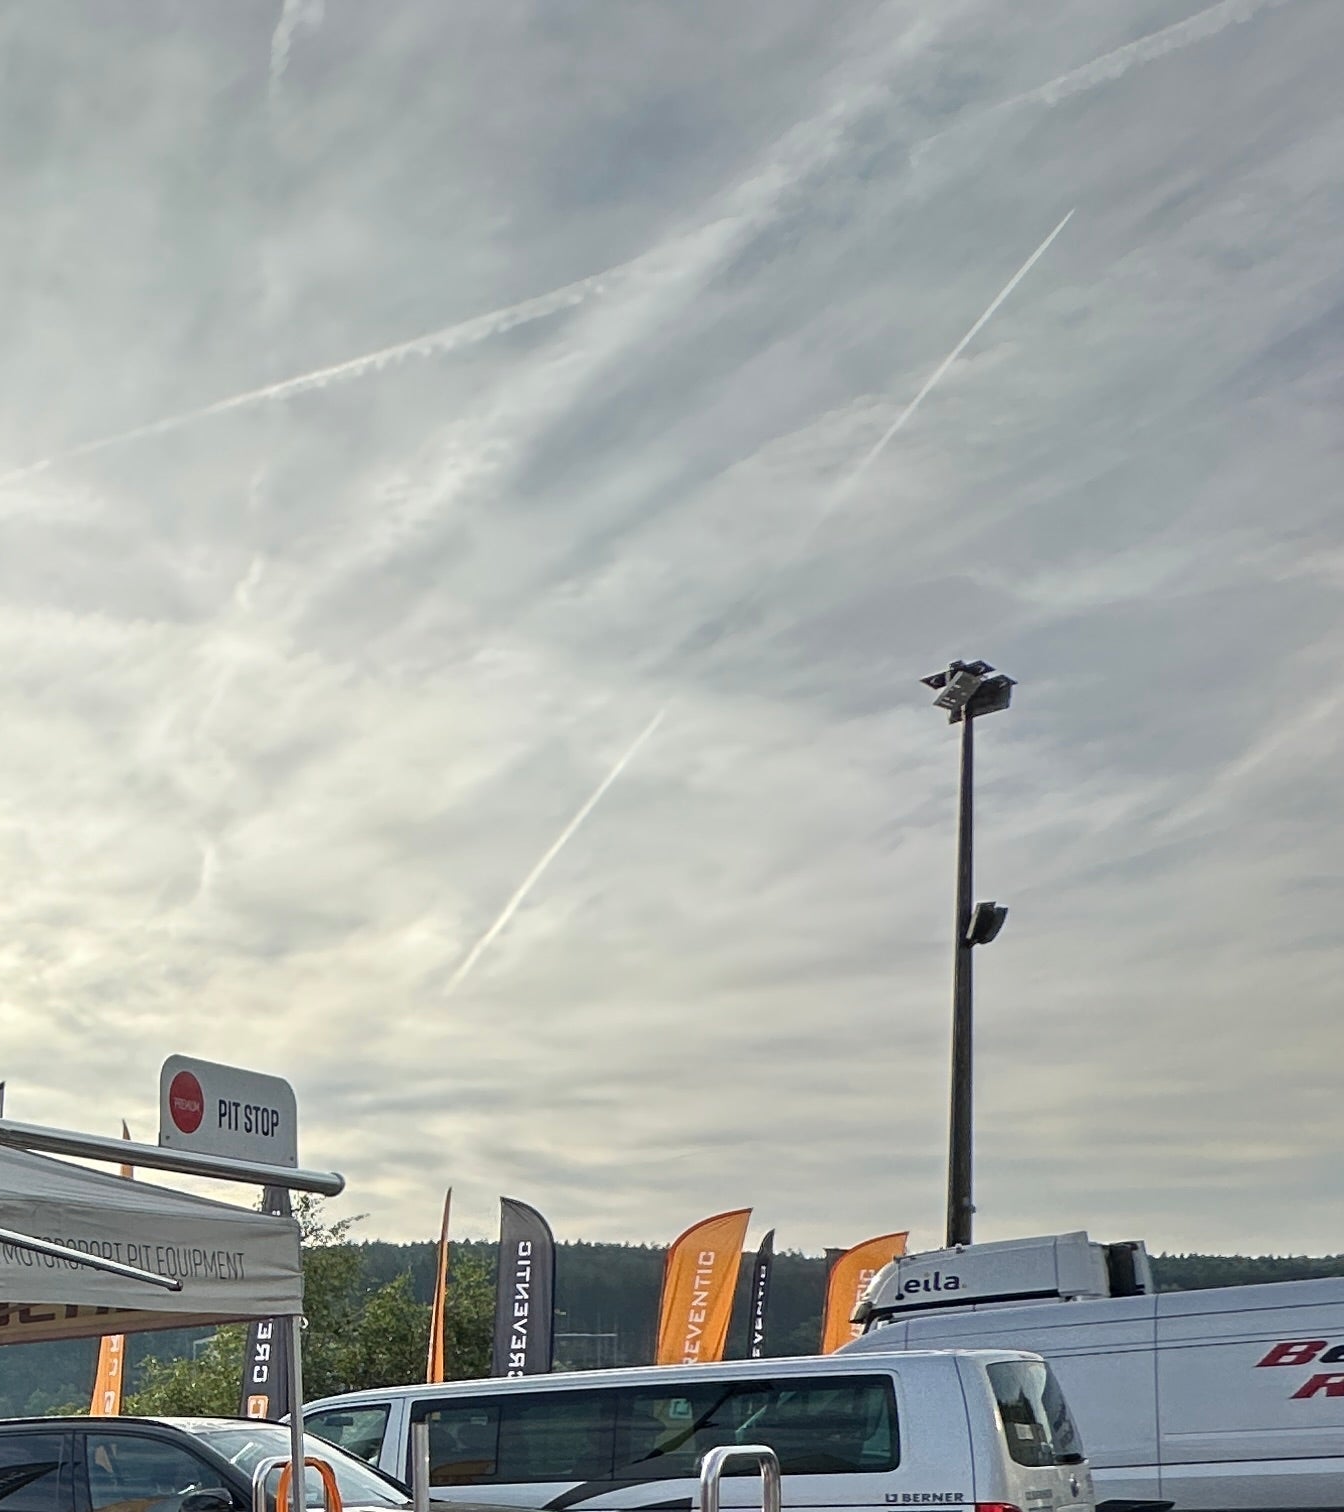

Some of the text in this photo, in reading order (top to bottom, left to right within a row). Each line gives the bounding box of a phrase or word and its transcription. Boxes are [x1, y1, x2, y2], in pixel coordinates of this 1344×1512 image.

[219, 1099, 279, 1137] PIT STOP
[158, 1246, 245, 1280] EQUIPMENT
[902, 1492, 964, 1503] BERNER
